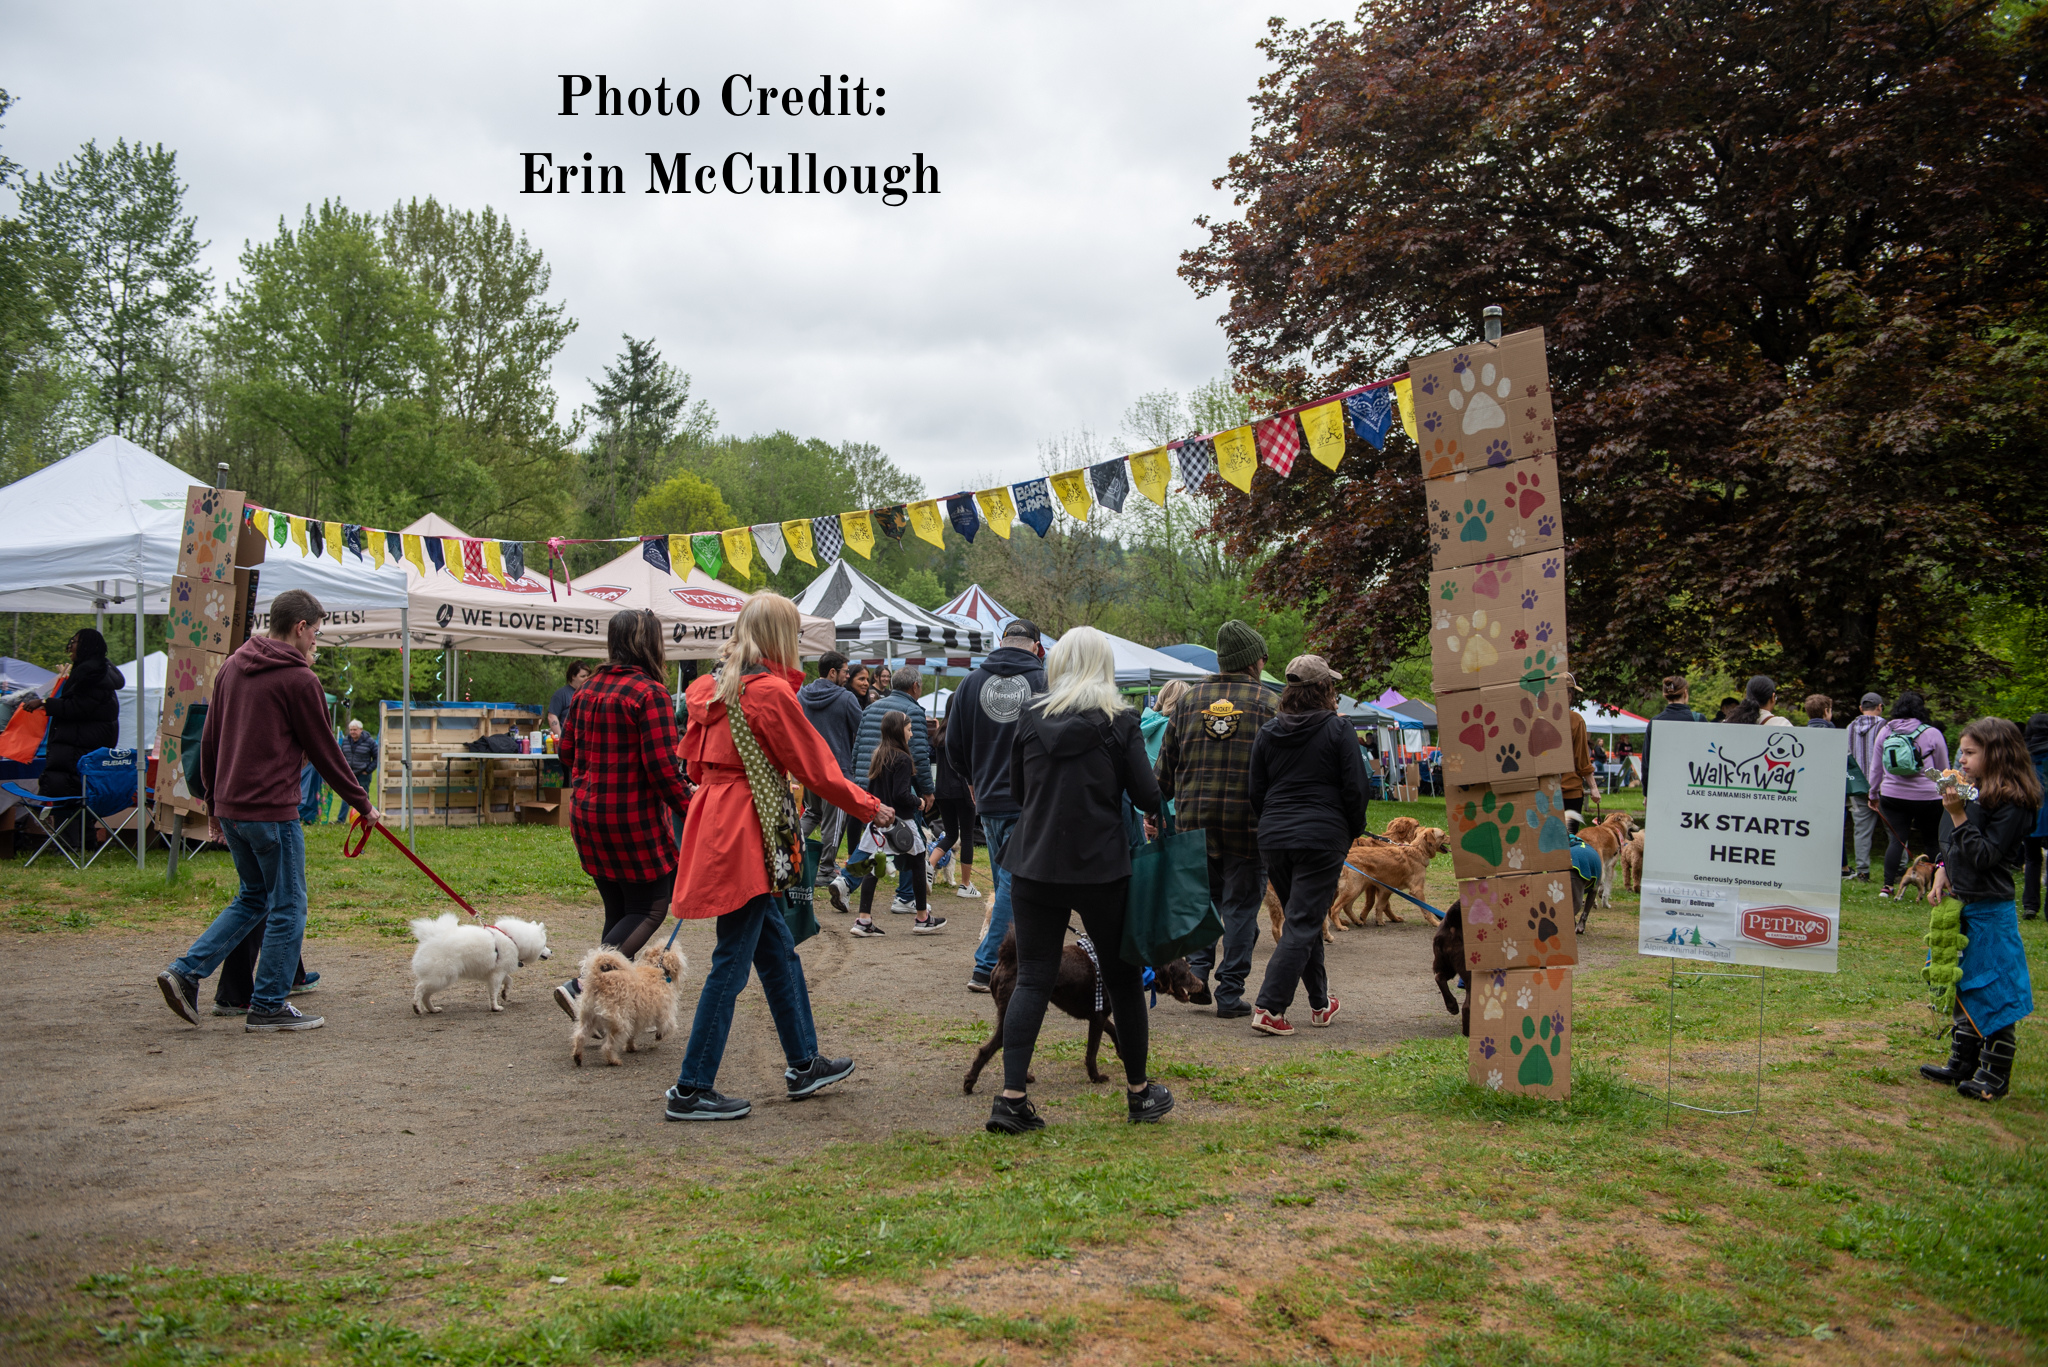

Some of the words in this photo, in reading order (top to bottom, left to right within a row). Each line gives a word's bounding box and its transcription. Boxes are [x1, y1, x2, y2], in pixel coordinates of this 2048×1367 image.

[461, 608, 492, 626] WE
[499, 612, 545, 631] LOVE
[552, 616, 599, 635] PETS!
[693, 626, 717, 639] WE
[102, 759, 132, 767] SUBARU
[1688, 761, 1734, 787] Walk
[1754, 764, 1796, 794] Wag
[1687, 789, 1706, 797] LAKE
[1707, 791, 1751, 799] SAMMAMISH
[1753, 793, 1776, 801] STATE
[1680, 812, 1710, 830] 3K
[1715, 814, 1811, 837] STARTS
[1710, 844, 1776, 867] HERE
[1693, 874, 1733, 884] Generously
[1734, 877, 1772, 887] Sponsored
[1773, 881, 1783, 889] by
[1657, 886, 1721, 898] MICHAEL'S
[1660, 896, 1681, 904] Subaru
[1689, 899, 1715, 907] Bellevue
[1644, 943, 1668, 952] Alpine
[1670, 945, 1697, 955] Animal
[1698, 948, 1731, 959] Hospital
